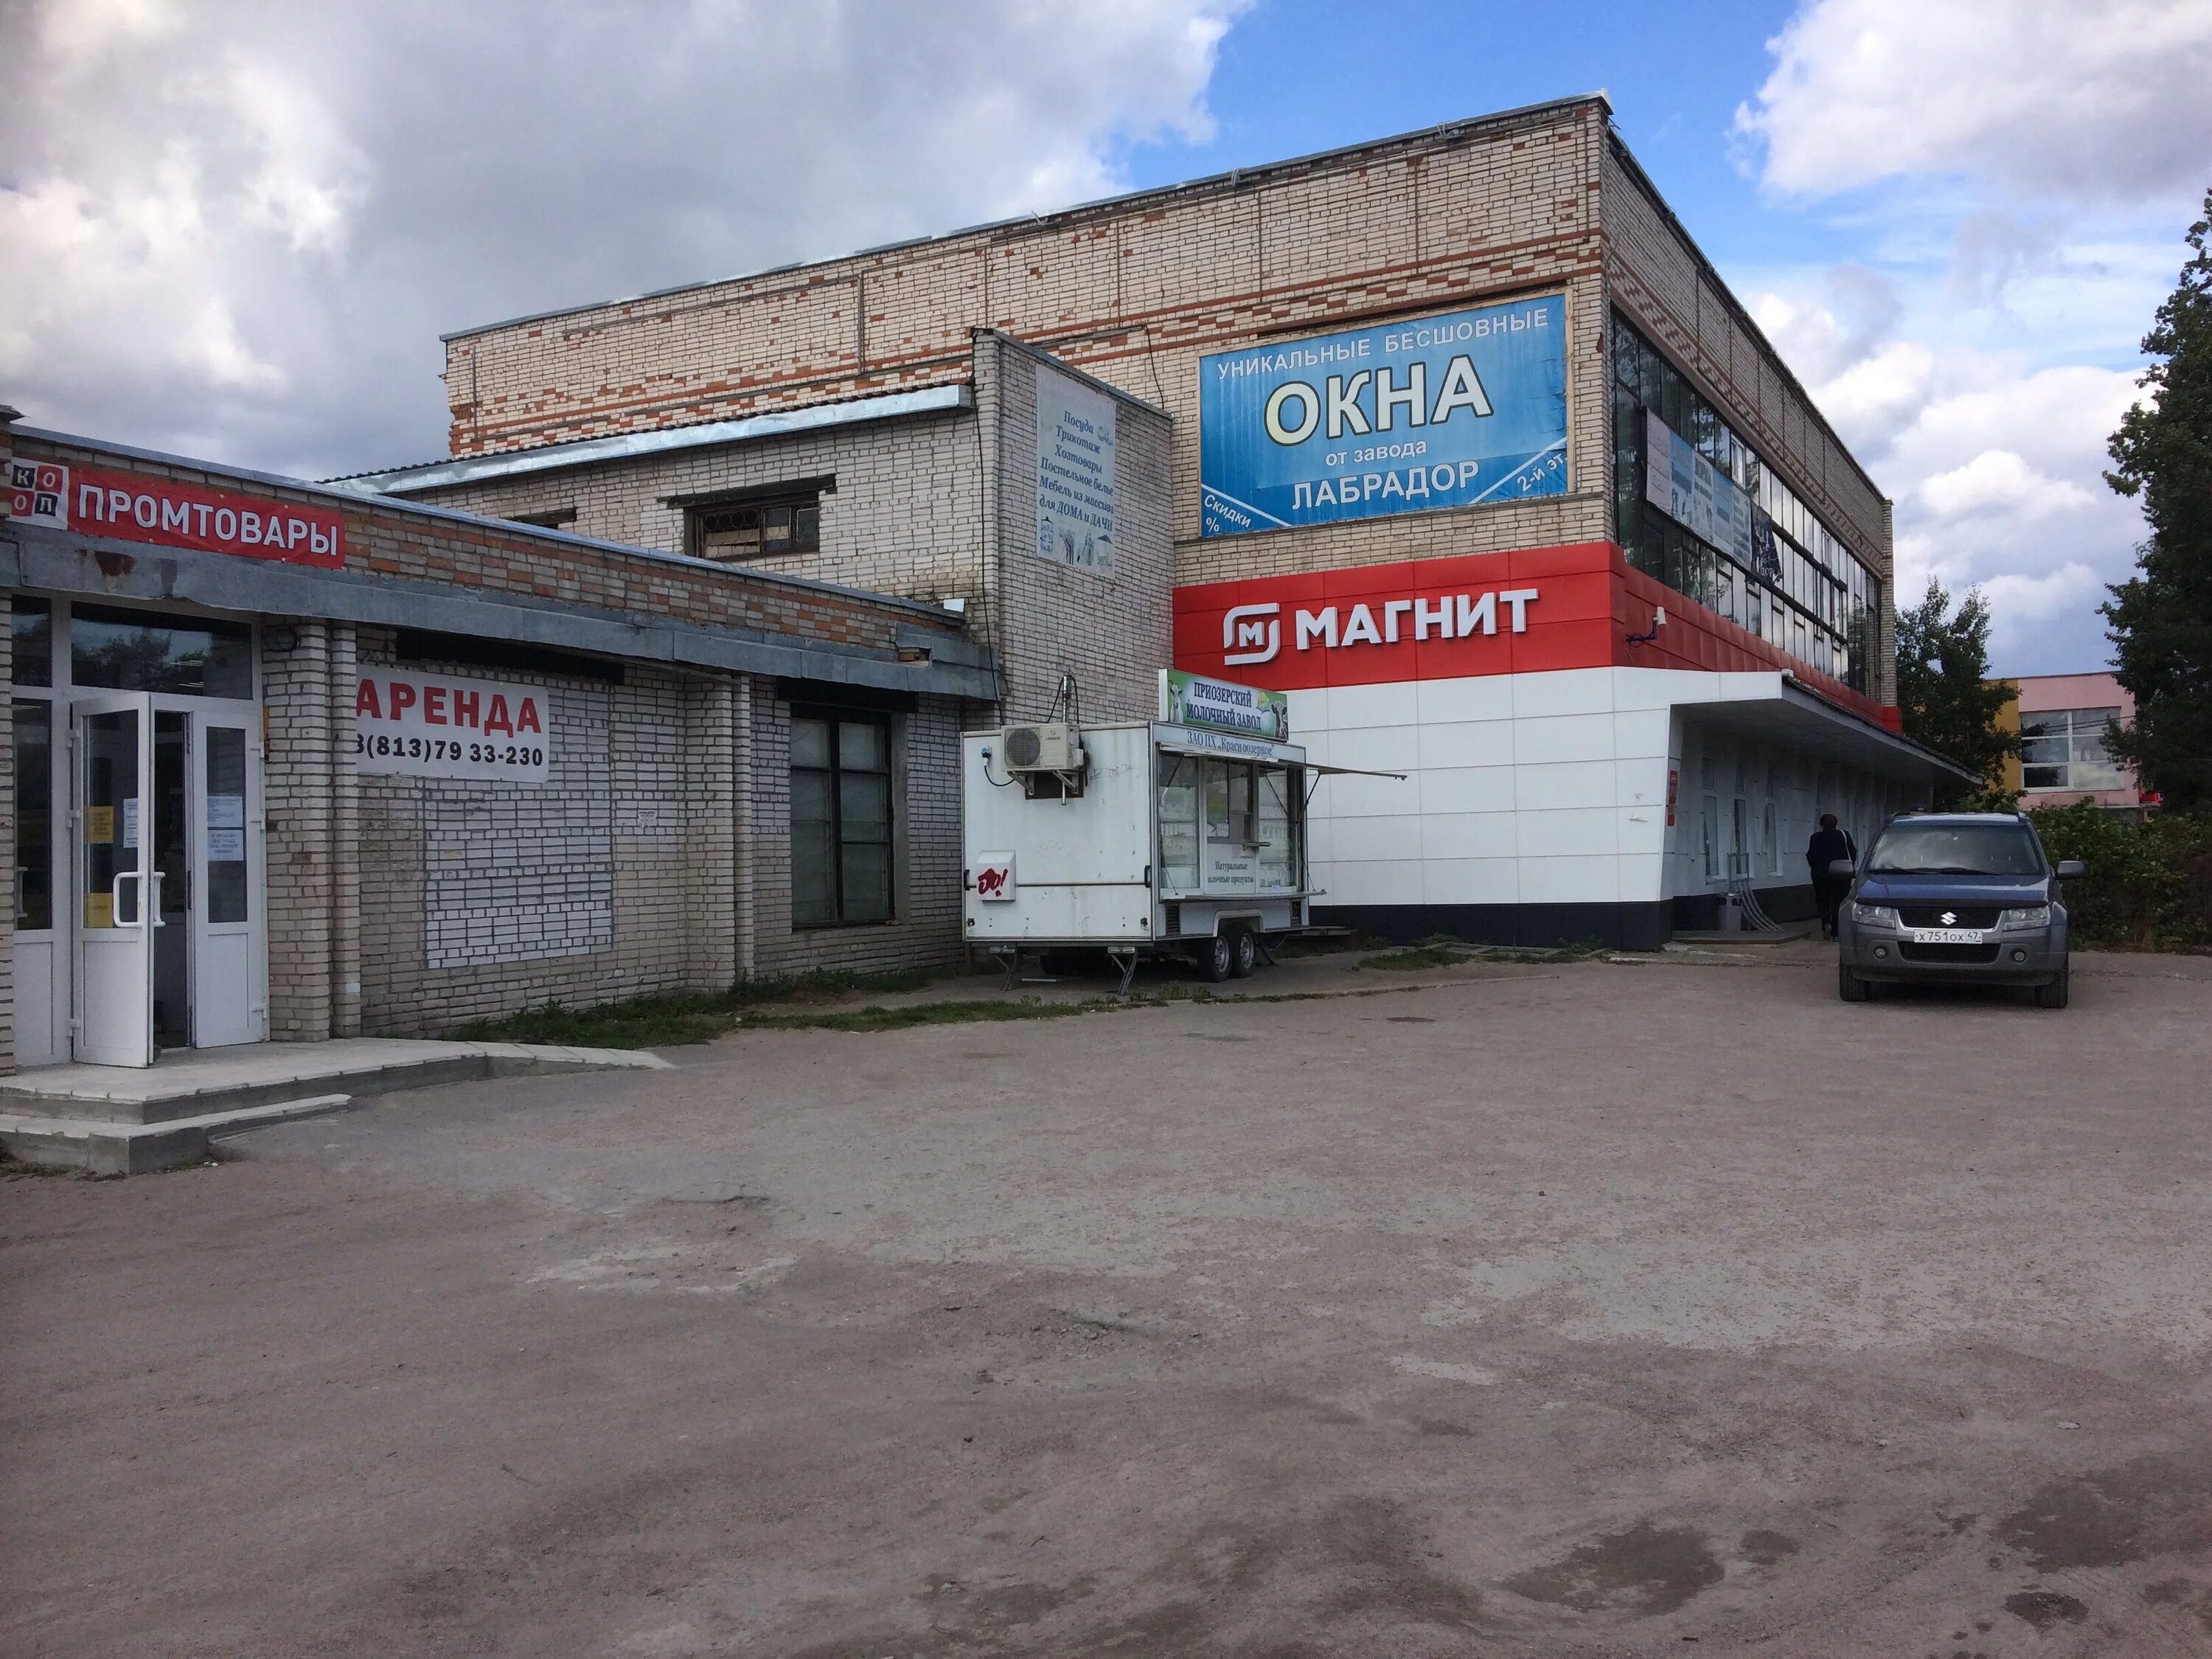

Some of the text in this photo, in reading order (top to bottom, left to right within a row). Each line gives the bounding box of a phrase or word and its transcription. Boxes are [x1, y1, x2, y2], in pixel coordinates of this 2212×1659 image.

[1217, 307, 1549, 380] УНИКАЛЬНЫЕ БЕСШОВНЫЕ
[1263, 354, 1495, 447] ОКНА
[1056, 425, 1102, 454] Трикотаж
[1064, 411, 1094, 434] Посуда
[1054, 444, 1103, 474] Хозтовары
[1325, 439, 1427, 467] от завода
[1040, 456, 1115, 497] Постельное белье
[1292, 460, 1480, 510] ЛАБРАДОР
[1517, 451, 1568, 493] 2-й эт.
[1039, 475, 1115, 515] Мебель из массива
[1039, 494, 1113, 532] для ДОМА и ДАЧИ
[1203, 493, 1252, 529] Скидки
[78, 484, 338, 556] ПРОМТОВАРЫ
[1206, 517, 1220, 532] %
[1295, 588, 1540, 651] МАГНИТ
[356, 678, 542, 738] АРЕНДА
[1193, 681, 1252, 708] ПРИОЗЕРСКИЙ
[1186, 703, 1262, 731] МОЛОЧНЫЙ ЗАВОД
[470, 743, 543, 766] 33-230
[1187, 731, 1203, 746] ЗАО
[1205, 735, 1216, 748] ПХ
[1214, 860, 1248, 873] Натуральные
